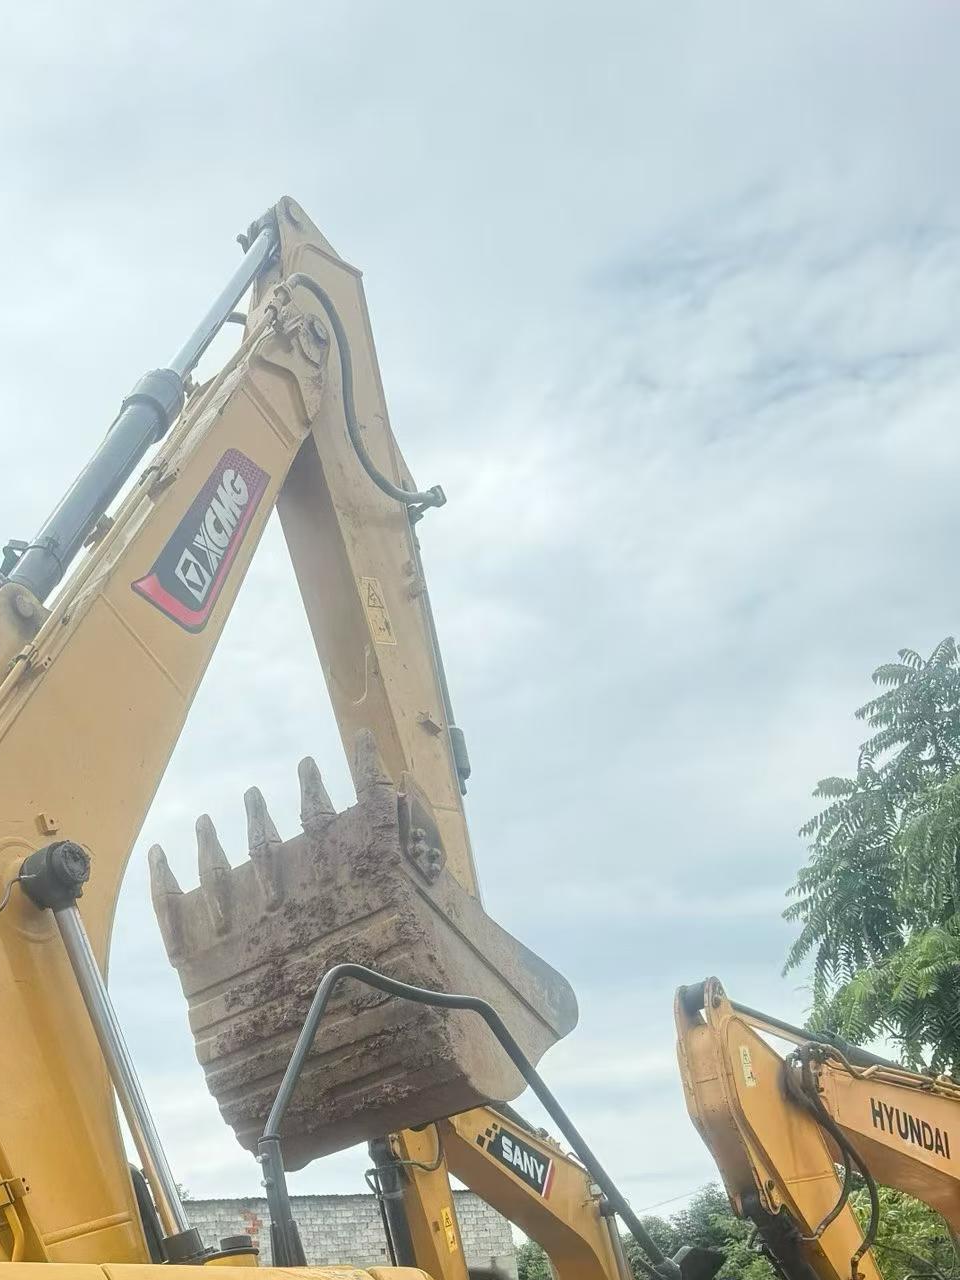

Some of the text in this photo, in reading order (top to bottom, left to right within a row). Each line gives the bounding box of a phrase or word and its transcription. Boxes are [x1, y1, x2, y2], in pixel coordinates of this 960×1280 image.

[192, 469, 249, 576] XCMG
[501, 1135, 545, 1185] SANY
[870, 1097, 951, 1160] HYUNDAI
